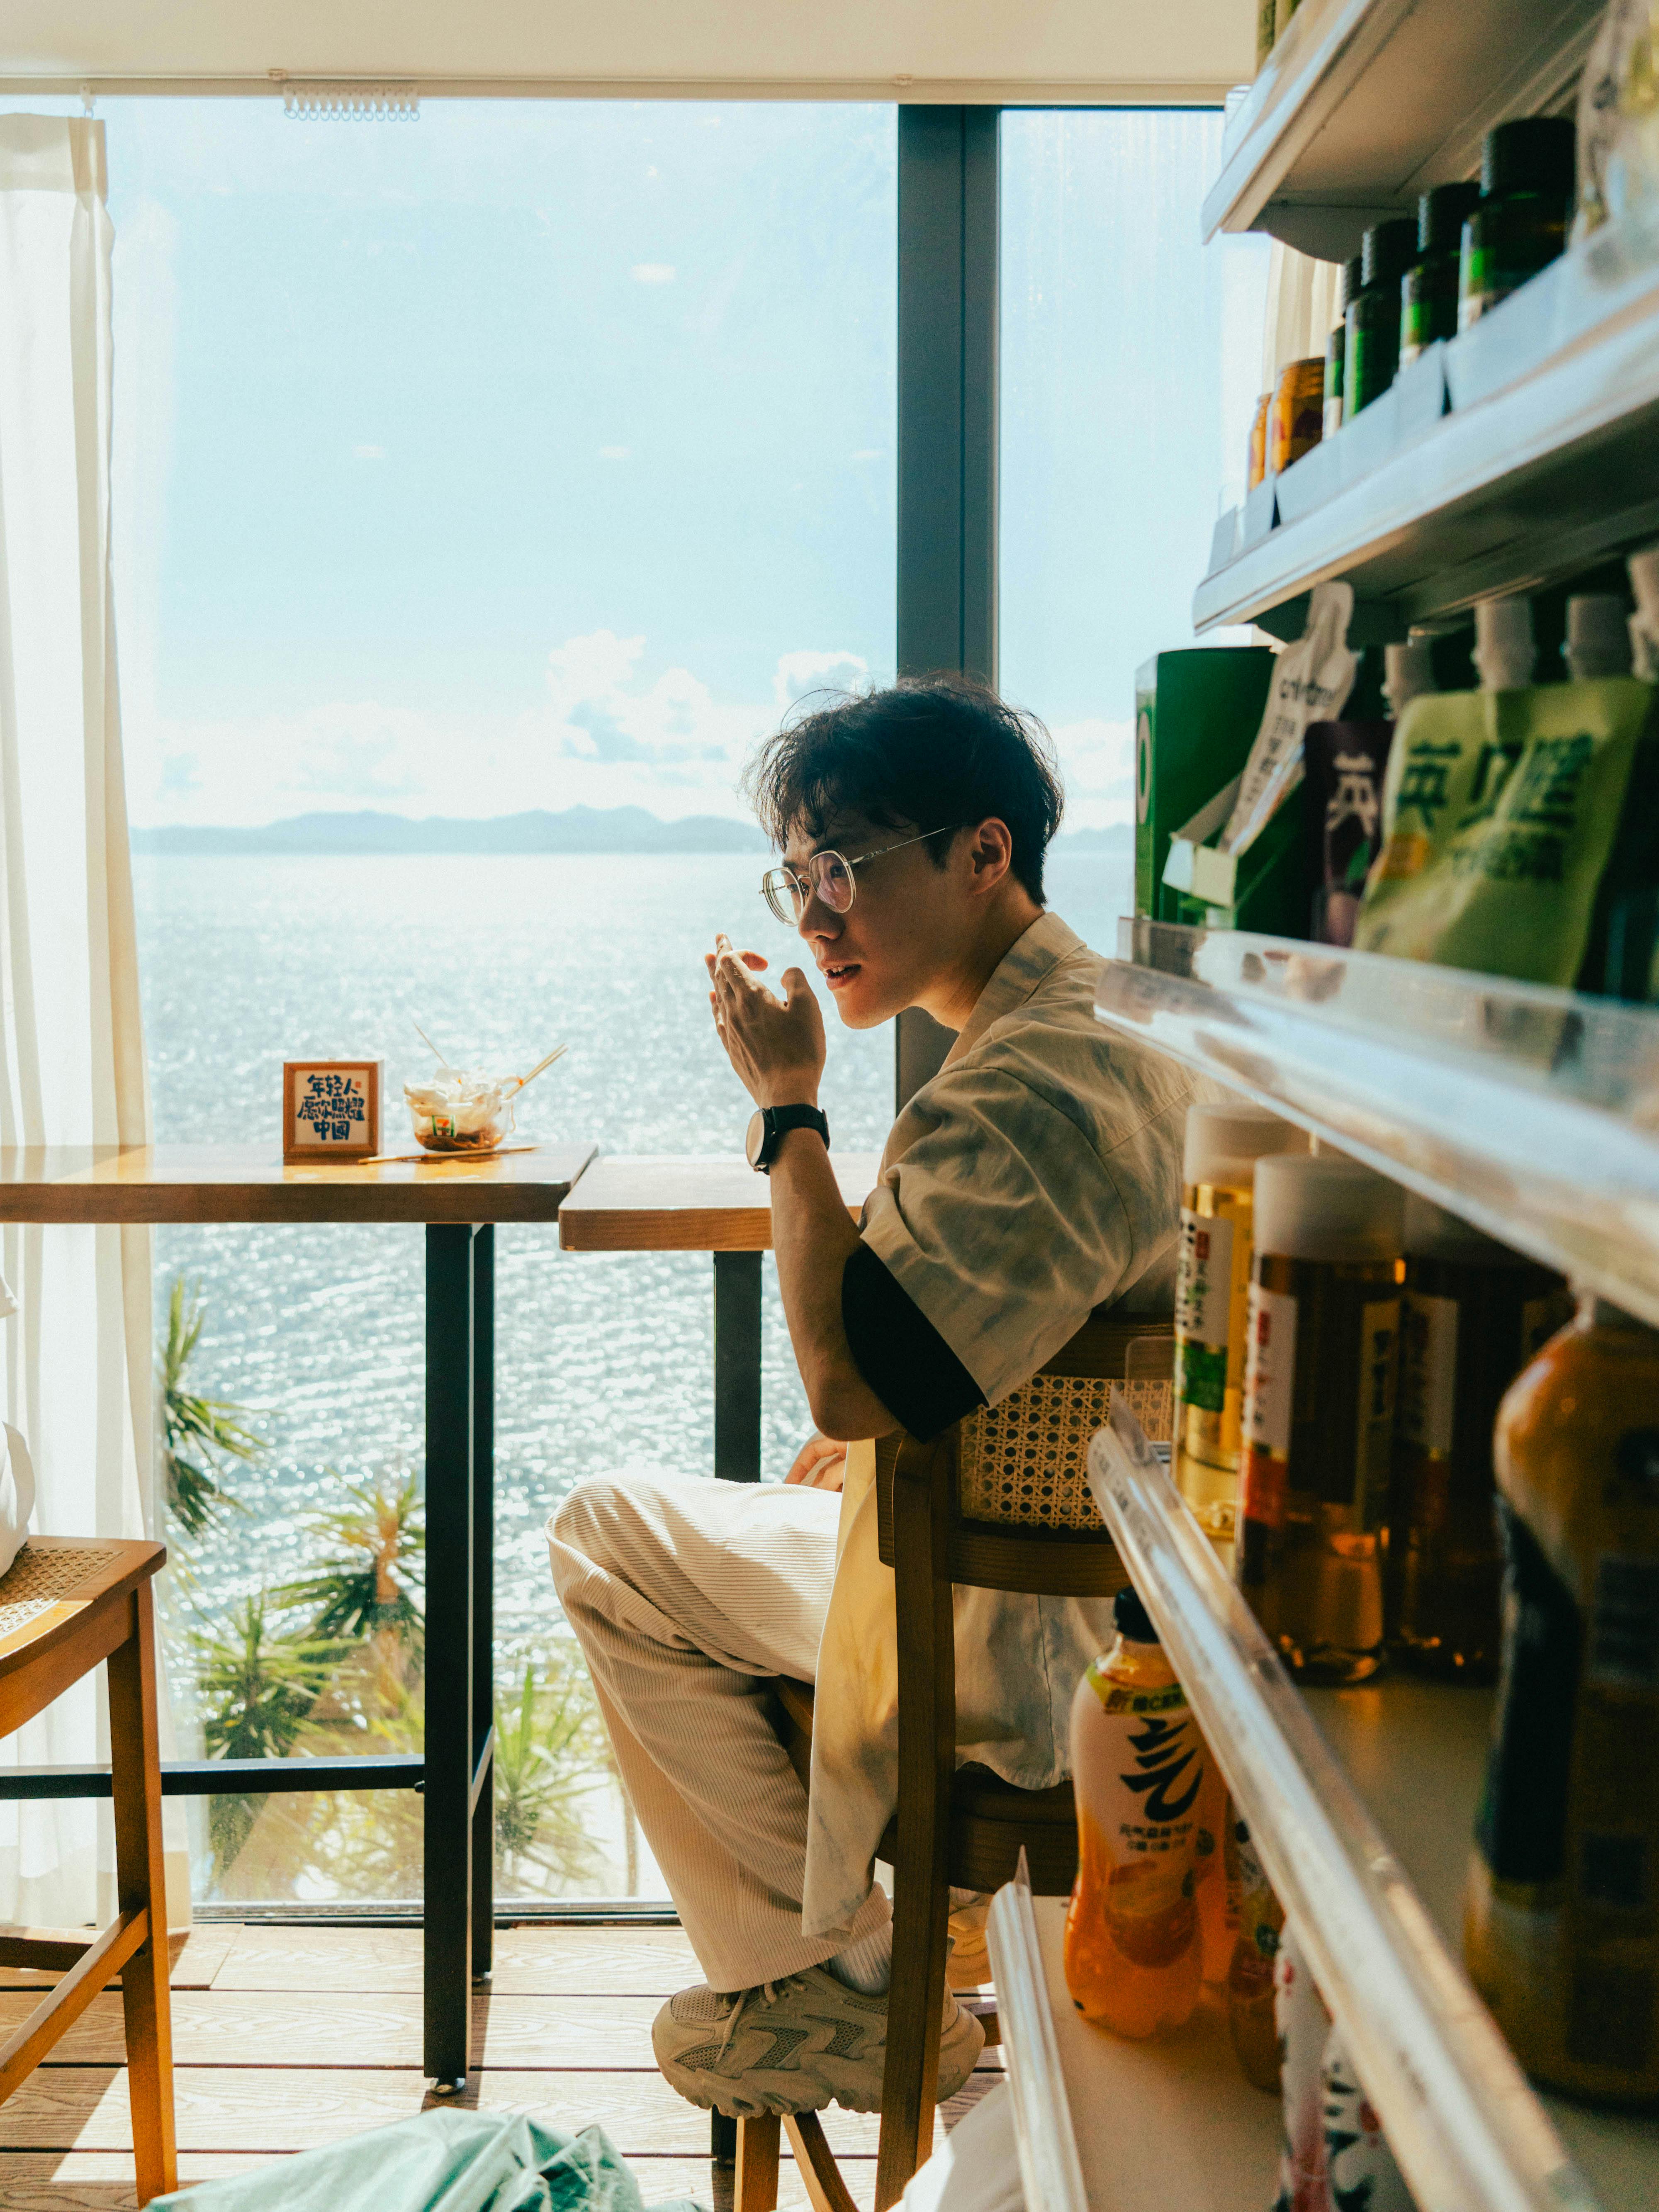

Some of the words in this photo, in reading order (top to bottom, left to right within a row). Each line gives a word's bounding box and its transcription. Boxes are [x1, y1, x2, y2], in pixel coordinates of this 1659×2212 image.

[307, 1074, 358, 1098] 年轻人
[297, 1095, 365, 1121] 愿你照耀
